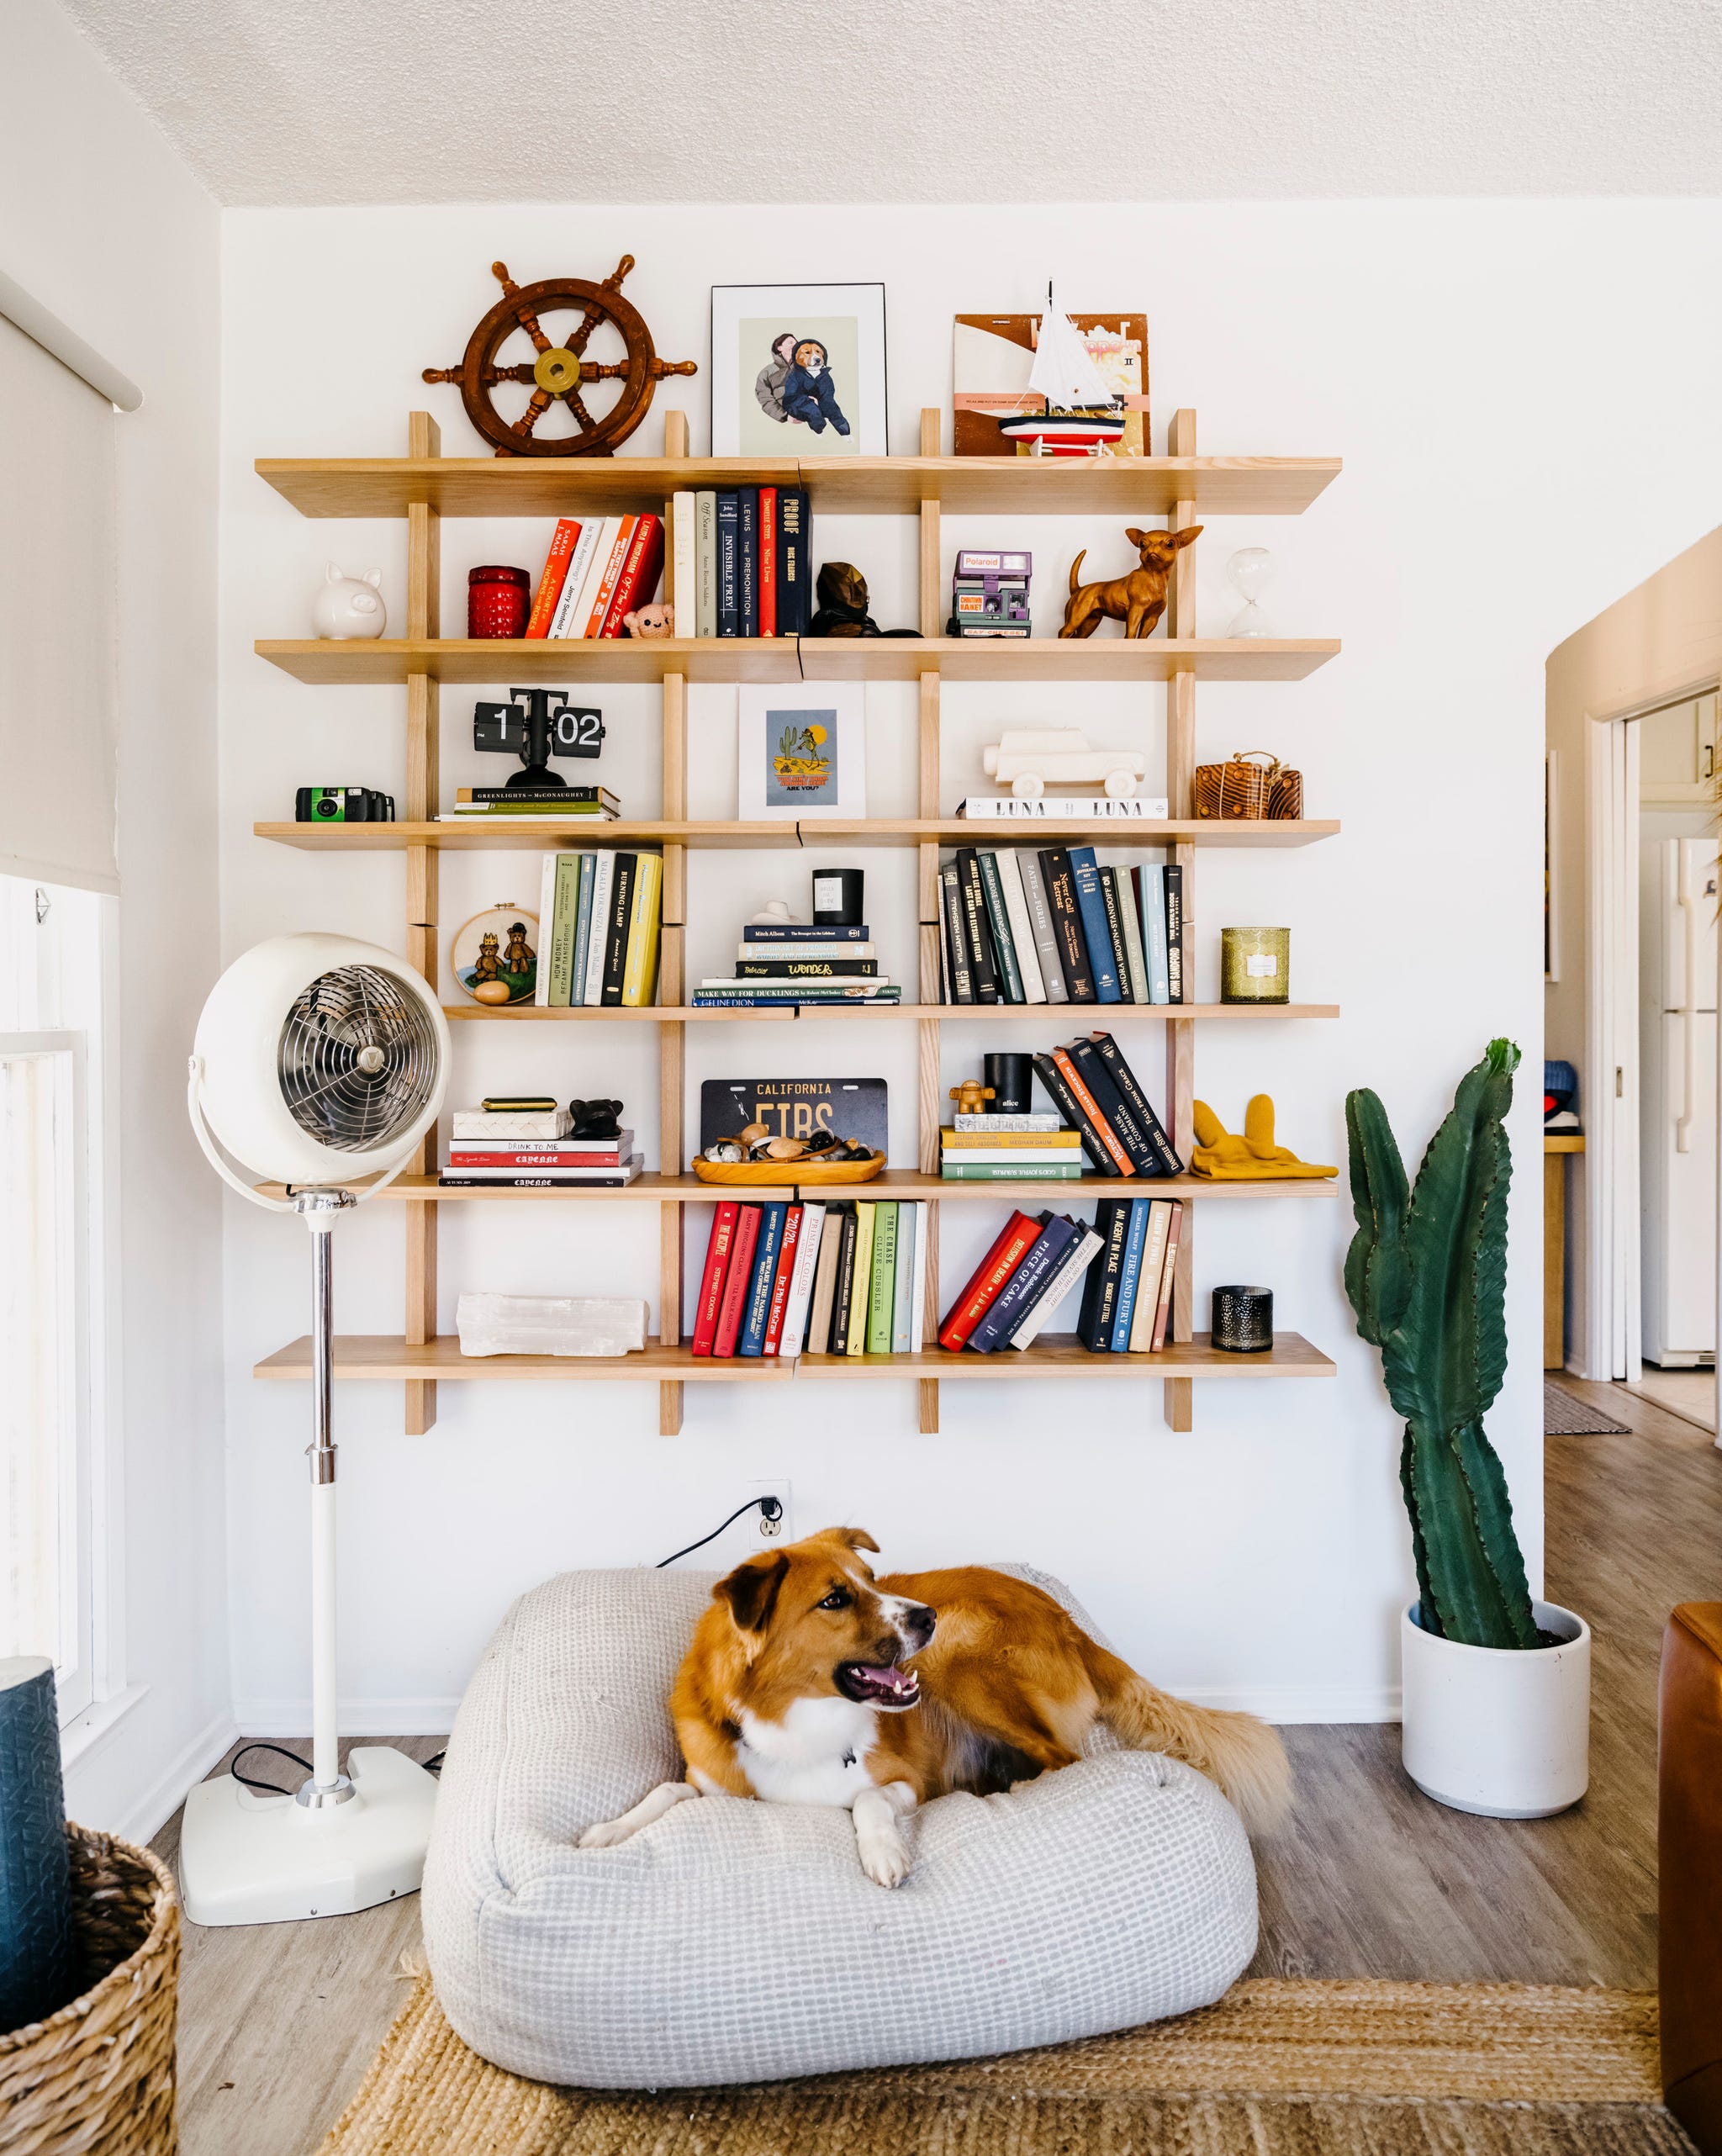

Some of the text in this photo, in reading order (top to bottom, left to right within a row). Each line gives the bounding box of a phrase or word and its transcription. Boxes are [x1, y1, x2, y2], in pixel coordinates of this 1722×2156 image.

[701, 502, 710, 515] Off
[784, 499, 799, 533] PROOF
[550, 532, 563, 556] MAAS
[558, 528, 570, 556] SARAH
[583, 533, 591, 547] This
[621, 519, 650, 588] LAURA INGRAHAM Of
[571, 548, 587, 581] Anything?
[966, 557, 998, 566] Polaroid
[529, 563, 552, 631] THORNS ROSES
[541, 585, 554, 612] COURT
[564, 584, 574, 602] Jerry
[557, 603, 569, 630] Seinfeld
[494, 709, 600, 746] 1 02
[996, 802, 1142, 816] LUNA LUNA
[969, 859, 978, 878] JAMES
[615, 870, 627, 927] BURNING LAMP
[1027, 864, 1038, 889] FATES
[1034, 900, 1047, 929] FURIES
[1051, 880, 1066, 909] Retreat
[1059, 872, 1075, 913] Never Call
[591, 860, 608, 975] MALALA YOUSAFZAI Malala
[950, 896, 959, 933] MARSHALL
[964, 885, 973, 899] LAST
[969, 919, 979, 942] ELYSIAN
[986, 869, 998, 898] PURPOSE
[993, 900, 1003, 925] DRIVEN
[1002, 949, 1012, 971] WARREN
[562, 923, 570, 964] DANGEROUS
[954, 934, 963, 963] WILLIAM
[1103, 887, 1129, 995] SANDRA BROWN STANDOFF
[788, 964, 832, 975] WONDER
[955, 970, 970, 996] INCHES
[1129, 941, 1144, 997] THE MERCY SEAT
[1170, 947, 1180, 996] JOHN SANDFORD
[757, 1083, 832, 1095] CALIFORNIA
[1064, 1065, 1085, 1096] STOCKWIN
[1081, 1095, 1097, 1116] JULIAN
[1116, 1068, 1179, 1170] DANIELLE STEEL FALL FROM GRACE
[1113, 1113, 1128, 1134] MASK
[1117, 1103, 1142, 1141] COMMAND
[508, 1142, 531, 1150] DRINK
[1081, 1123, 1110, 1163] Mary Higgins Clark
[1103, 1133, 1124, 1161] VICTORY
[1125, 1133, 1138, 1151] THE
[1138, 1141, 1148, 1153] OF
[1115, 1208, 1125, 1219] AN
[1134, 1207, 1143, 1231] MICHAEL
[740, 1231, 748, 1255] HIGGINS
[765, 1210, 777, 1252] HARVEY MACKAY
[784, 1217, 798, 1243] 20/20
[1112, 1220, 1123, 1242] AGENT
[799, 1218, 818, 1297] PRIMARY COLORS
[885, 1236, 893, 1264] CHASE
[990, 1238, 1025, 1285] DELUSION IN DEATH
[1056, 1239, 1092, 1287] OF THE SEVENTH
[1107, 1252, 1118, 1273] PLACE
[705, 1223, 730, 1320] THE STEPHEN COONTS
[736, 1256, 744, 1276] CLARK
[763, 1255, 773, 1283] BEWARE
[1000, 1239, 1049, 1308] PIECE OF CAKE
[1017, 1256, 1049, 1302] Derek Robinson
[1043, 1265, 1059, 1286] CATHOLIC
[1126, 1254, 1137, 1276] FIRE
[873, 1268, 882, 1311] CUSSLER
[1049, 1266, 1080, 1308] ON THE NIGHT
[1104, 1282, 1114, 1302] ROBERT
[1123, 1276, 1133, 1298] AND
[725, 1313, 733, 1332] ALONE
[756, 1298, 765, 1322] NAKED
[769, 1304, 781, 1334] McGraw
[1119, 1299, 1130, 1324] FURY
